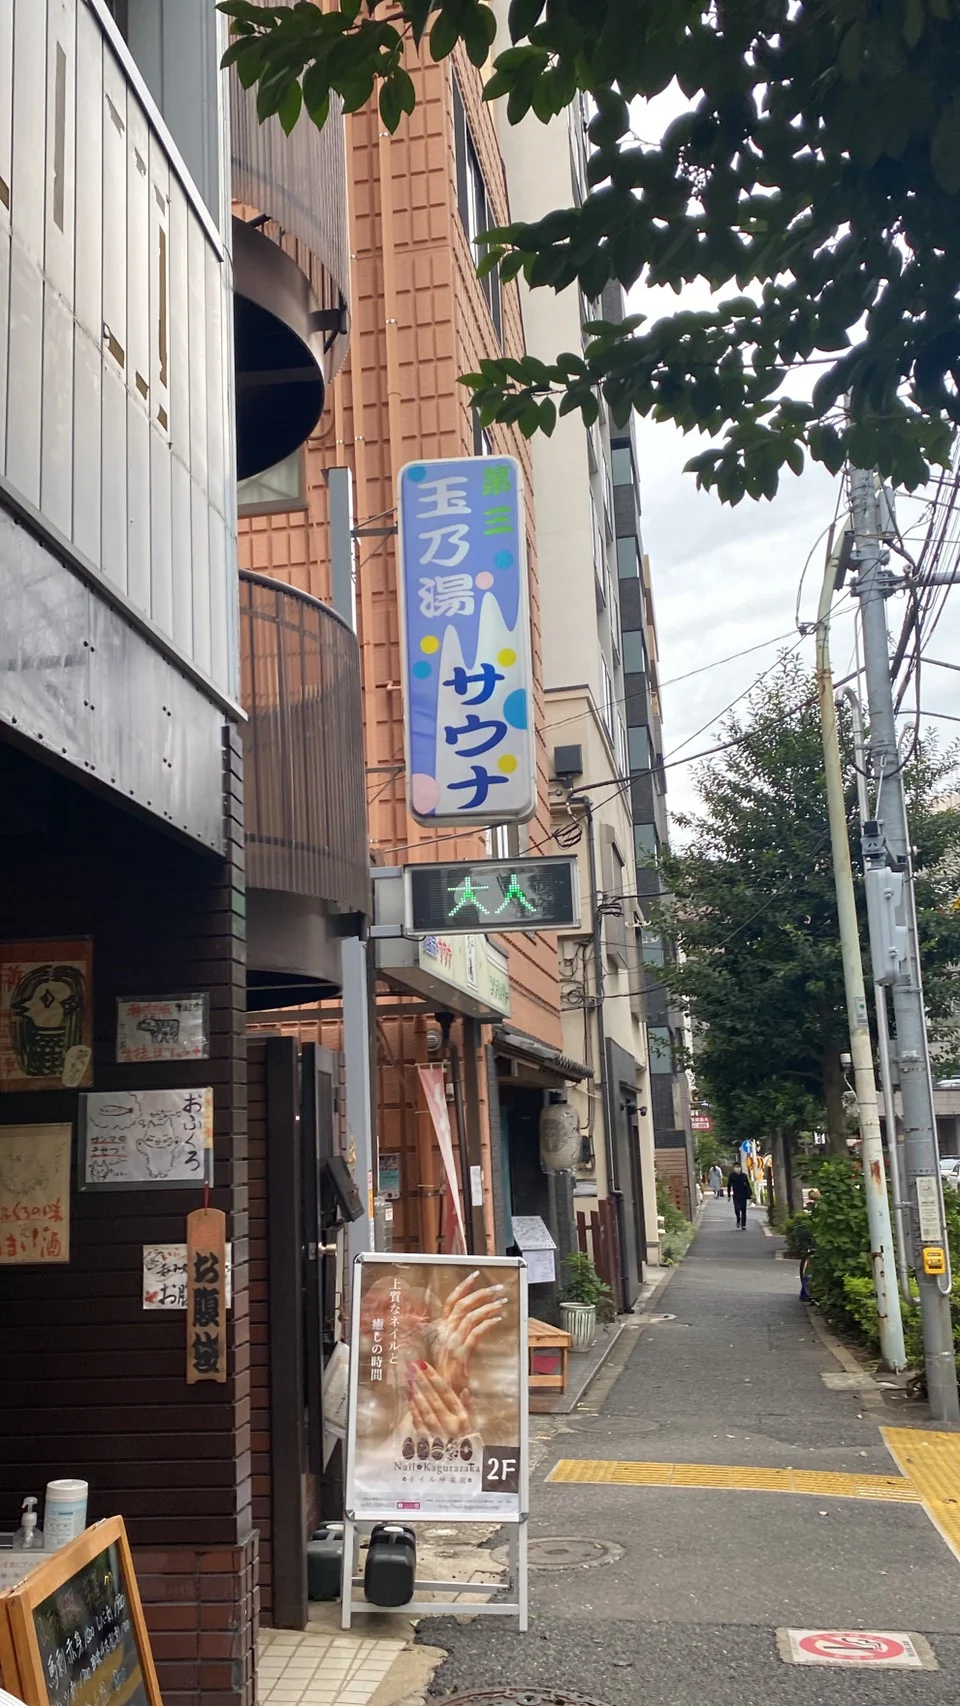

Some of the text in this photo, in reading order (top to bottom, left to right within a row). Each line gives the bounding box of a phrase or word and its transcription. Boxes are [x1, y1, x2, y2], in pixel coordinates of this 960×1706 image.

[482, 465, 514, 536] 第三
[416, 476, 474, 618] 玉乃湯
[442, 662, 509, 810] サウナ
[447, 873, 538, 917] 大人
[182, 1092, 203, 1172] おふくろ
[370, 1318, 384, 1381] 癒しの時間
[389, 1277, 402, 1365] 上質なネイルと
[393, 1461, 481, 1475] Nail Kagurazaka
[486, 1457, 517, 1481] 2F
